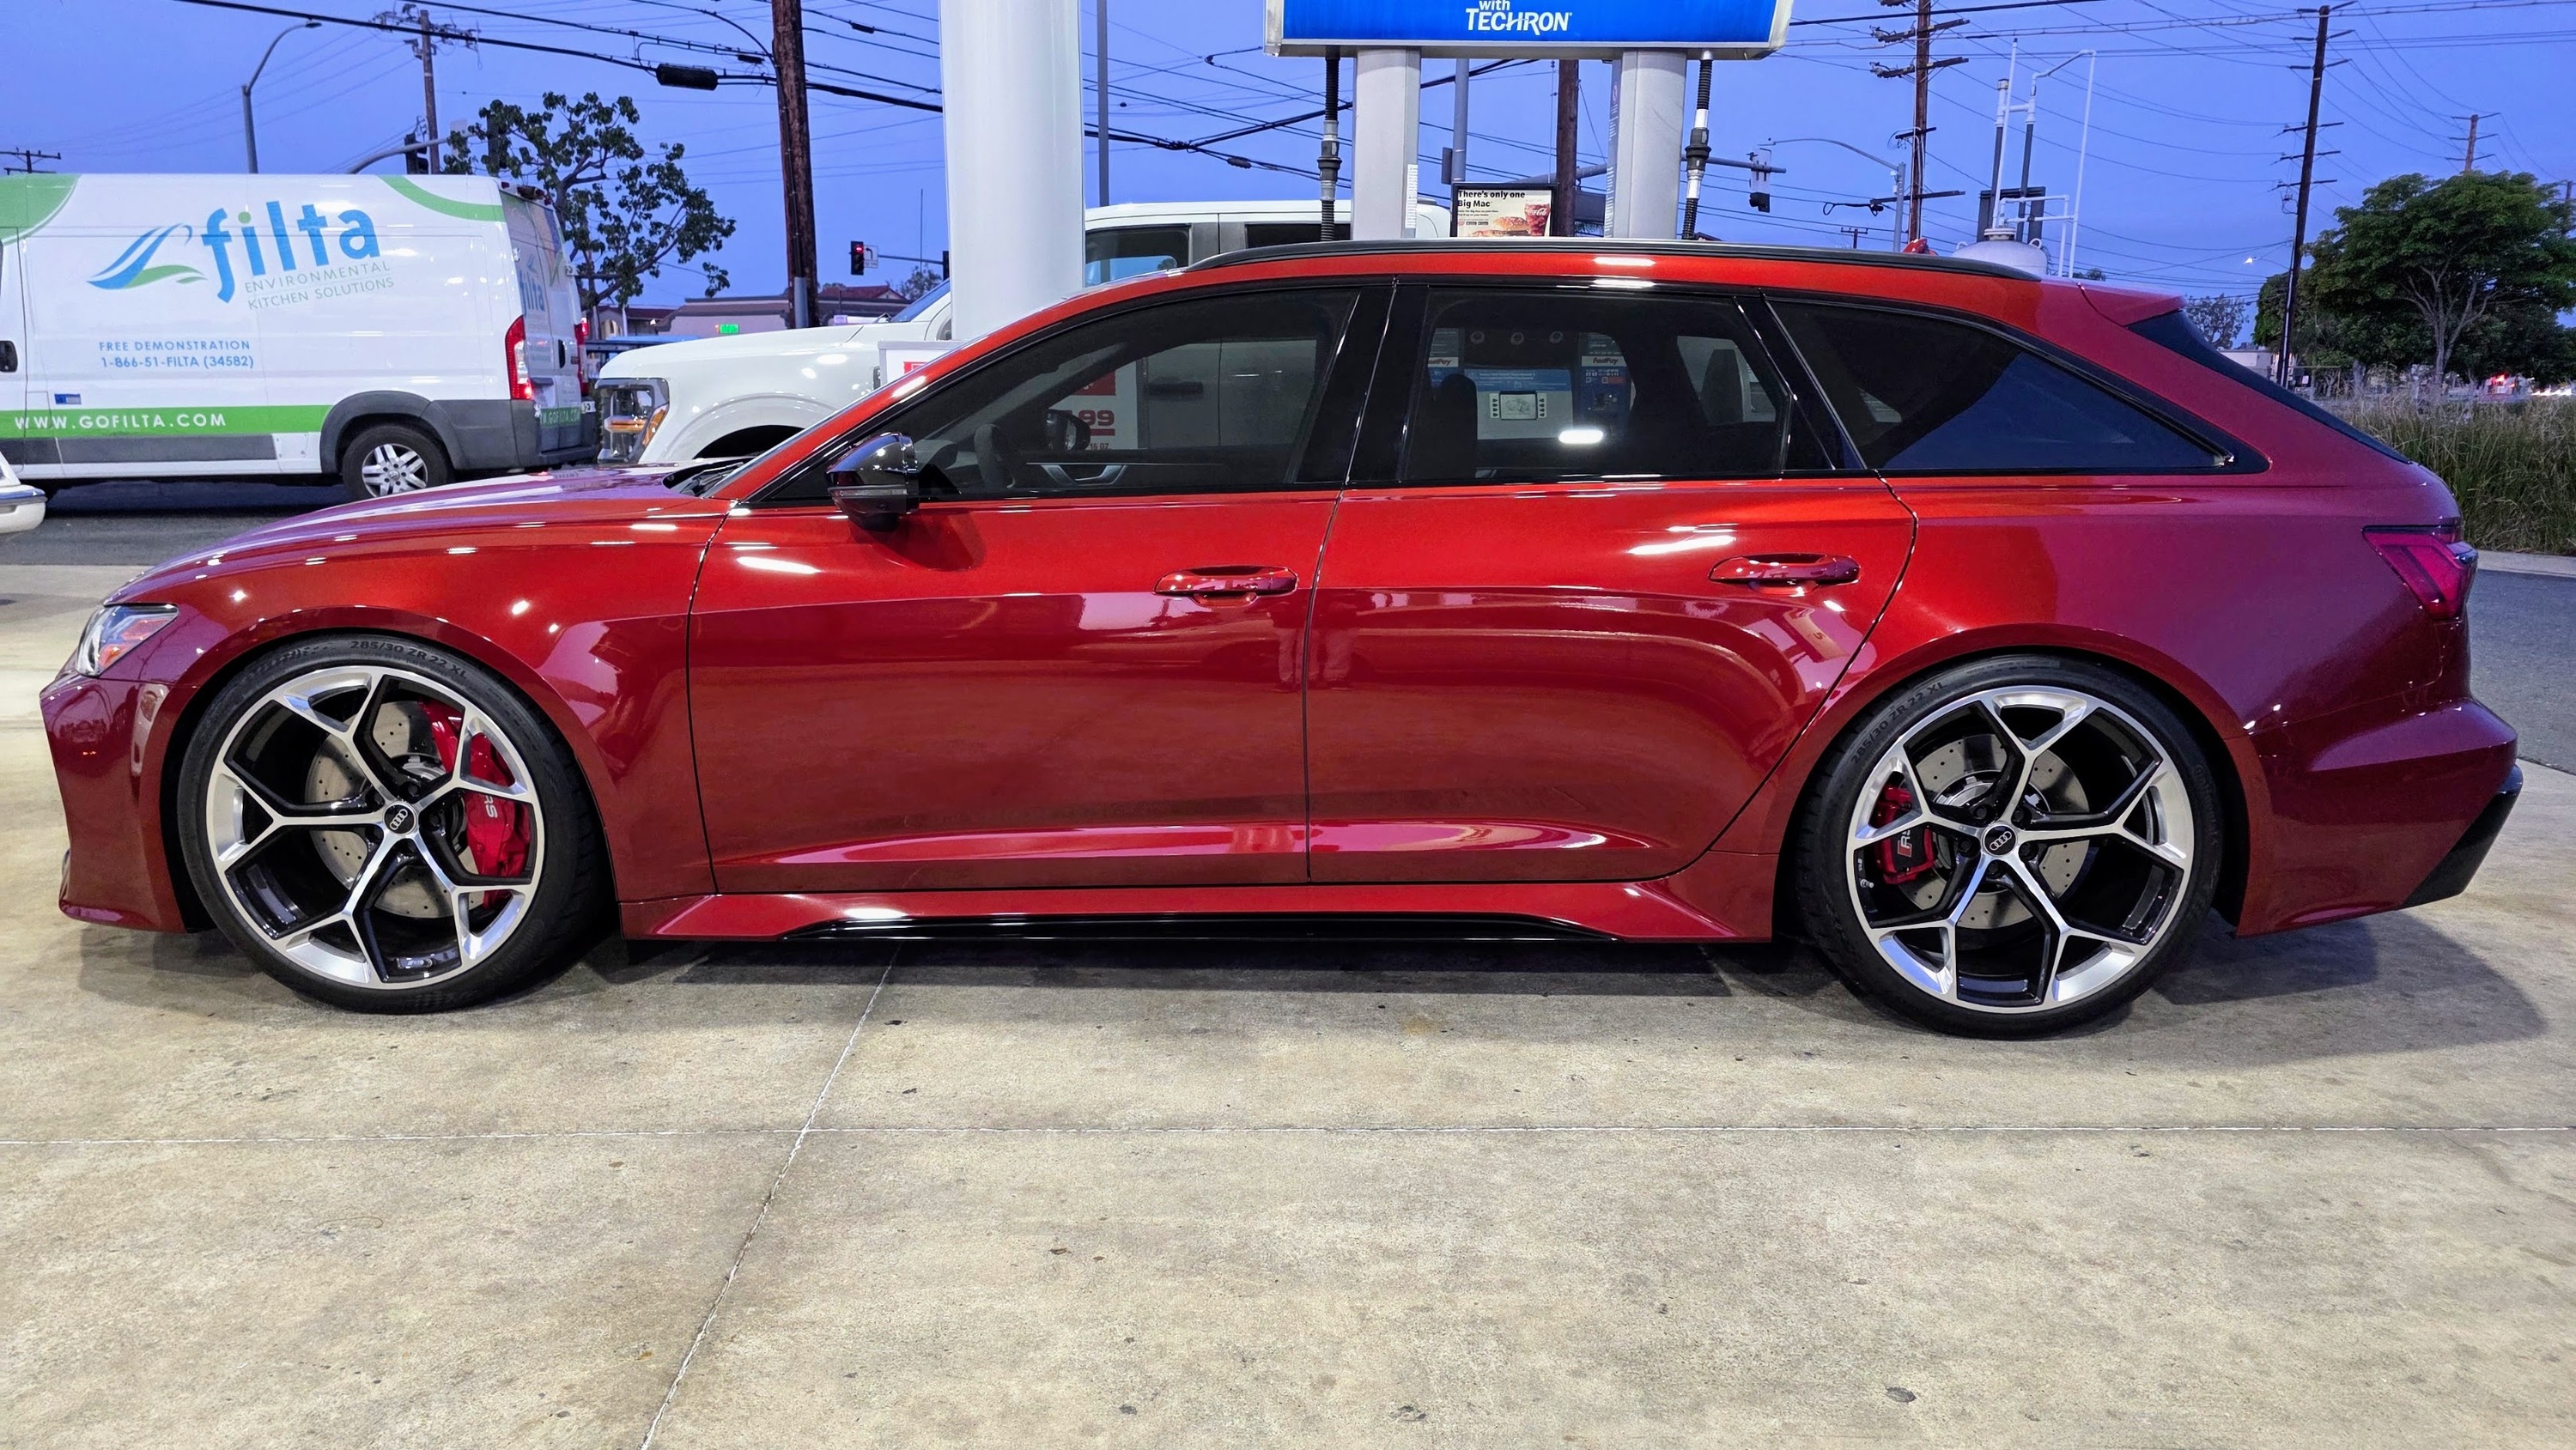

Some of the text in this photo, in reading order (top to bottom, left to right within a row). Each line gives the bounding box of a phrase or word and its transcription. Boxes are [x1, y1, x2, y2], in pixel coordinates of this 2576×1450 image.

[1479, 0, 1510, 11] with
[1466, 8, 1570, 35] TECHRON
[1458, 199, 1471, 208] Big
[1490, 191, 1508, 199] only
[200, 200, 381, 303] filta
[245, 261, 391, 294] ENVIRONMENTAL
[248, 277, 394, 310] KITCHEN SOLUTIONS
[99, 340, 250, 351] FREE DEMONSTRATION
[101, 355, 254, 369] 1-866-51-FILTA (34582)
[15, 413, 226, 430] WWW.GOFILTA.COM
[350, 640, 404, 653] 285/30
[407, 647, 428, 660] ZR
[429, 655, 447, 668] 22
[450, 664, 468, 679] XL
[1889, 704, 1908, 720] ZR
[1907, 692, 1924, 706] 22
